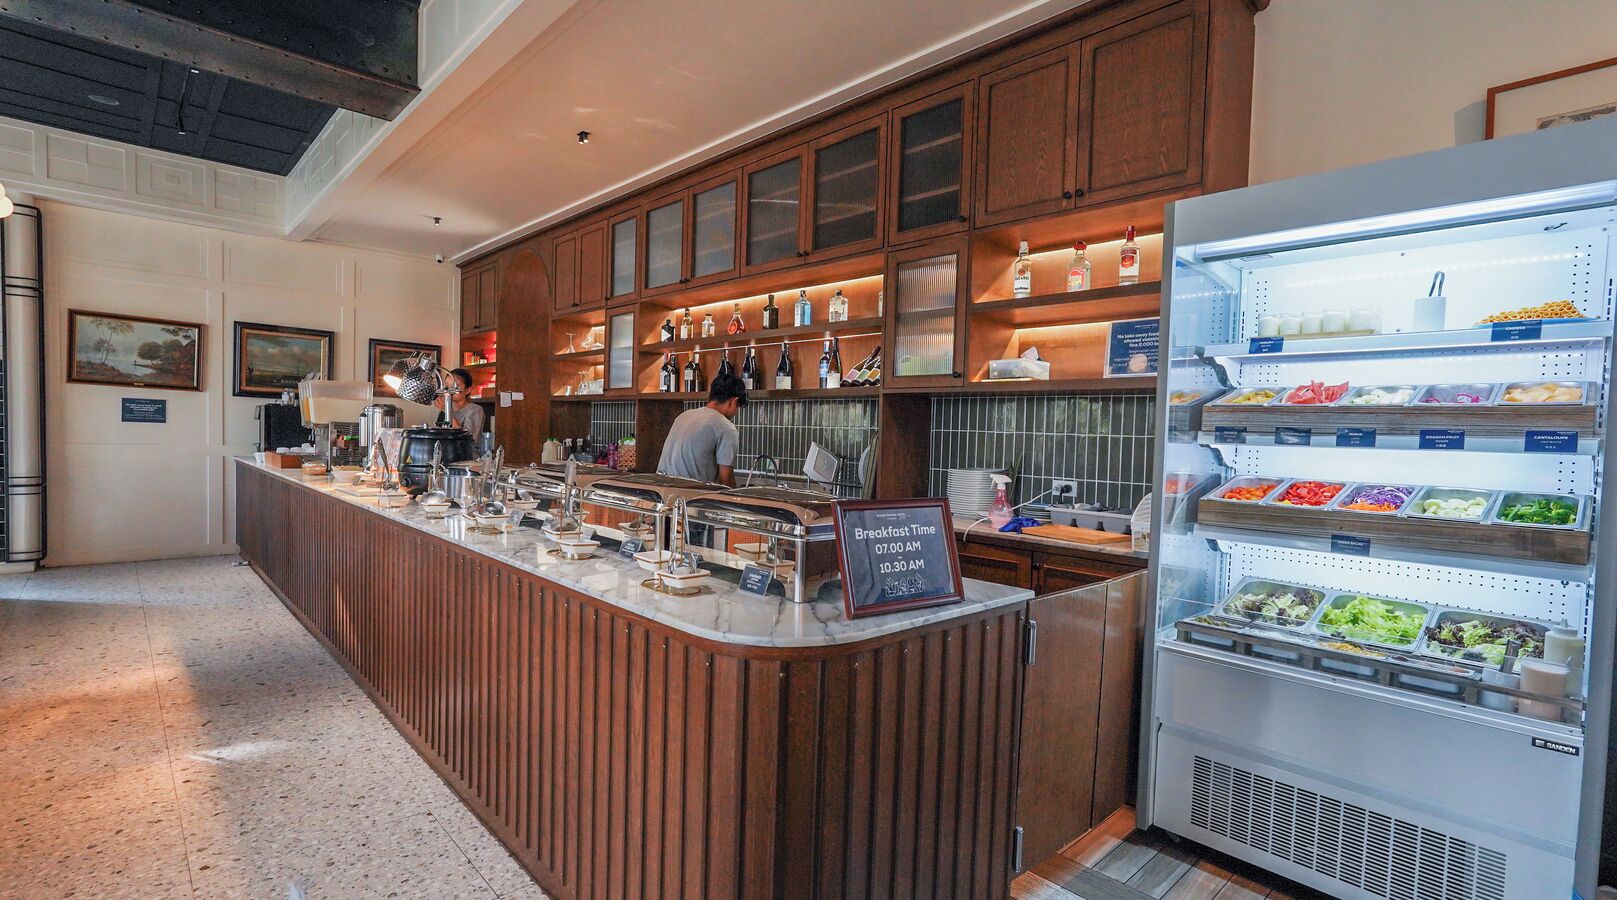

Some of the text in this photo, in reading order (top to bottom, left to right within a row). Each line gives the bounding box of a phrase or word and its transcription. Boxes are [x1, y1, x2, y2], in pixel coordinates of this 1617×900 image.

[854, 524, 936, 540] Breakfast Time
[875, 541, 922, 555] 07.00 AM
[879, 559, 925, 574] 10.30 AM
[1546, 742, 1576, 754] SANDEN
